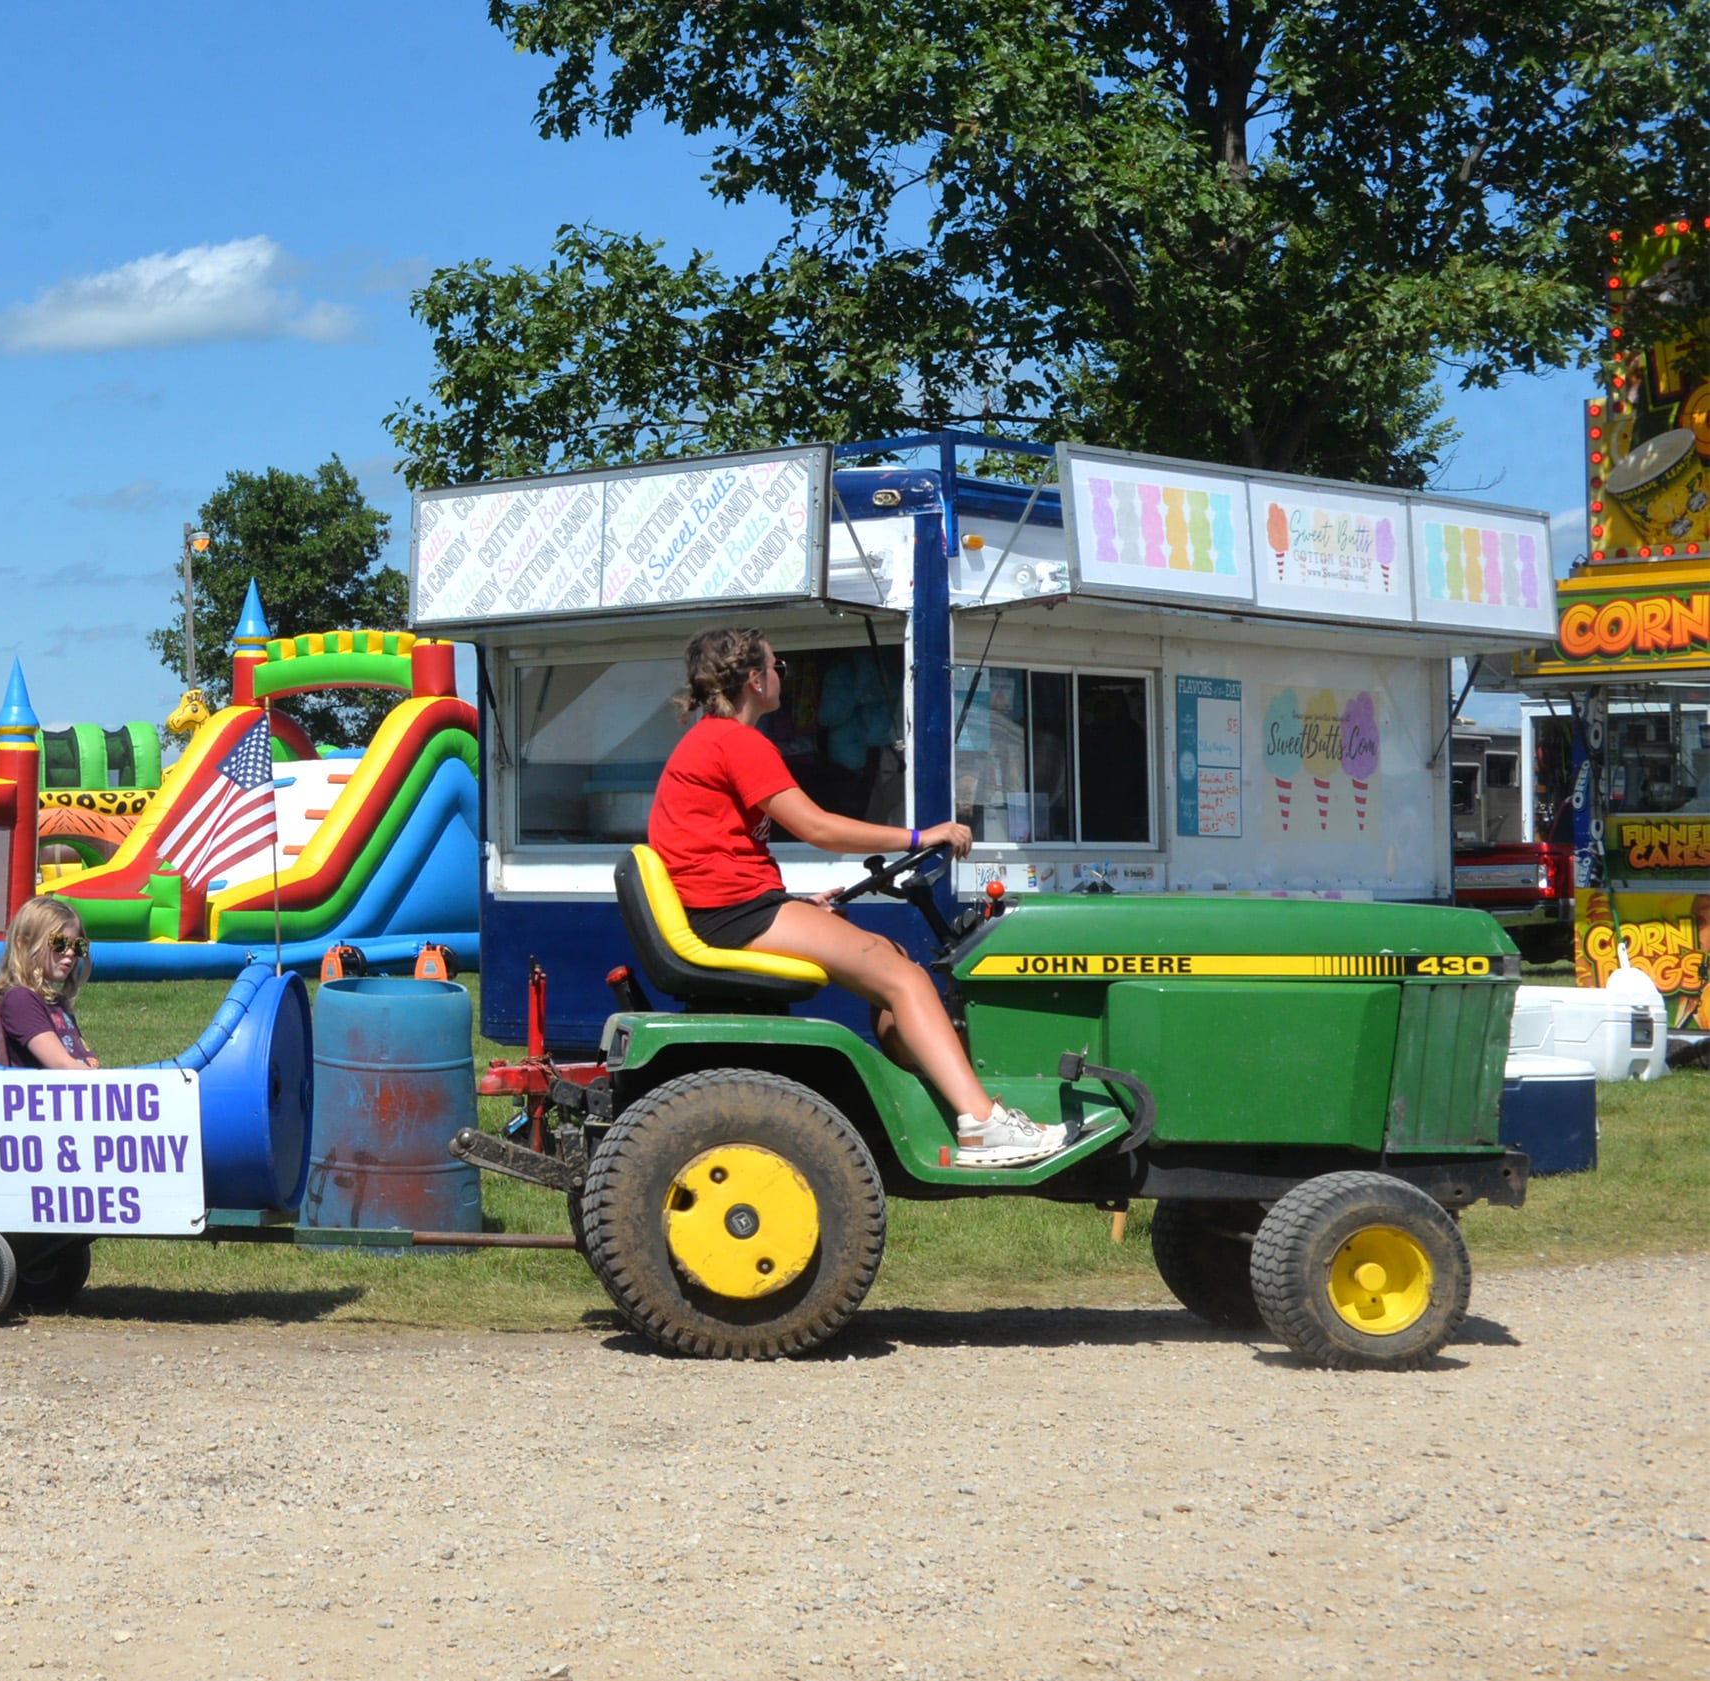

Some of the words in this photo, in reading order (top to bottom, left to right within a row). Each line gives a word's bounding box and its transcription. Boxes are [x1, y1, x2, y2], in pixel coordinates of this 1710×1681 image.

[477, 498, 531, 568] COTTON
[626, 492, 684, 565] COTTON
[648, 520, 697, 580] Sweet
[690, 470, 736, 524] Butts
[708, 476, 760, 543] CANDY
[1290, 509, 1332, 548] Sweet
[1338, 520, 1373, 552] Butts
[427, 531, 472, 593] CANDY
[498, 525, 543, 584] Sweet
[506, 539, 560, 610] COTTON
[552, 485, 600, 548] CANDY
[723, 512, 770, 566] Butts
[741, 517, 794, 586] CANDY
[1293, 550, 1335, 566] COTTON
[1339, 554, 1373, 570] CANDY
[1560, 592, 1710, 656] CORN
[1178, 678, 1213, 697] FLAVORS
[1225, 683, 1242, 698] DAY
[1267, 721, 1378, 760] SweetButts.Com
[1586, 918, 1694, 961] CORN
[1016, 957, 1089, 974] JOHN
[1102, 957, 1192, 974] DEERE
[1417, 956, 1490, 976] 430
[2, 1083, 160, 1122] PETTING
[57, 1135, 81, 1173] &
[93, 1135, 189, 1173] PONY
[31, 1186, 141, 1224] RIDES
